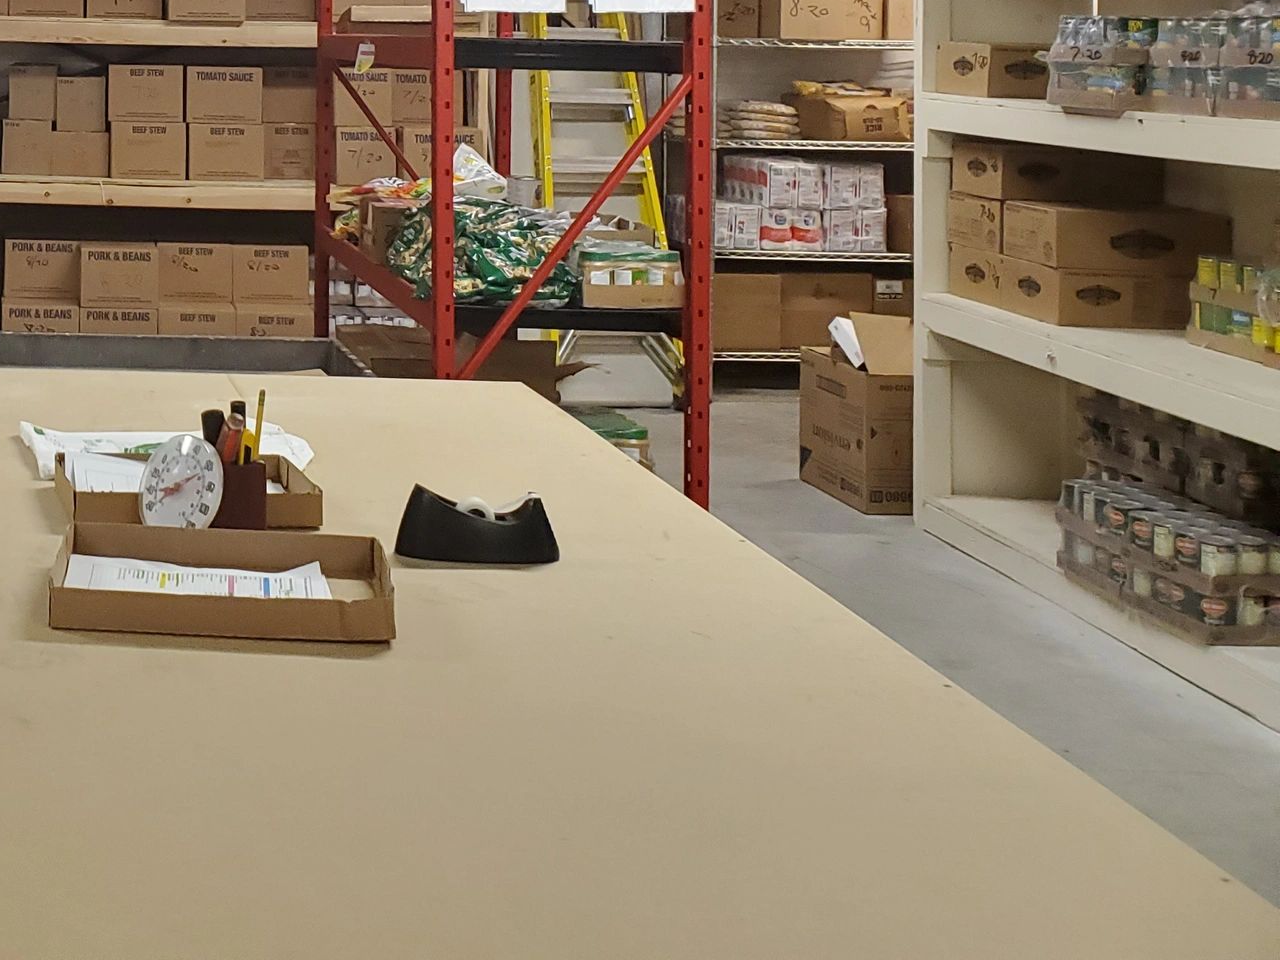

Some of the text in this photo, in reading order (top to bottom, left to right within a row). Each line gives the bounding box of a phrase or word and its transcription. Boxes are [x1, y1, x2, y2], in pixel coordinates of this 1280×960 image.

[130, 68, 164, 77] BEEF STEW
[196, 71, 254, 82] TOMATO SAUCE
[367, 73, 388, 82] SAUCE
[396, 74, 426, 84] TOMATO
[132, 126, 166, 135] BEEF STEW
[210, 127, 245, 136] BEEF STEW
[340, 132, 368, 142] TOMATO
[12, 242, 73, 254] PORK & BEANS
[178, 247, 213, 257] BEEF STEW
[88, 251, 151, 263] PORK & BEANS
[254, 249, 289, 259] BEEF STEW
[9, 308, 72, 320] PORK & BEANS
[87, 311, 150, 323] PORK & BEANS
[180, 313, 216, 324] BEEF STEW
[258, 316, 294, 327] BEEF STEW
